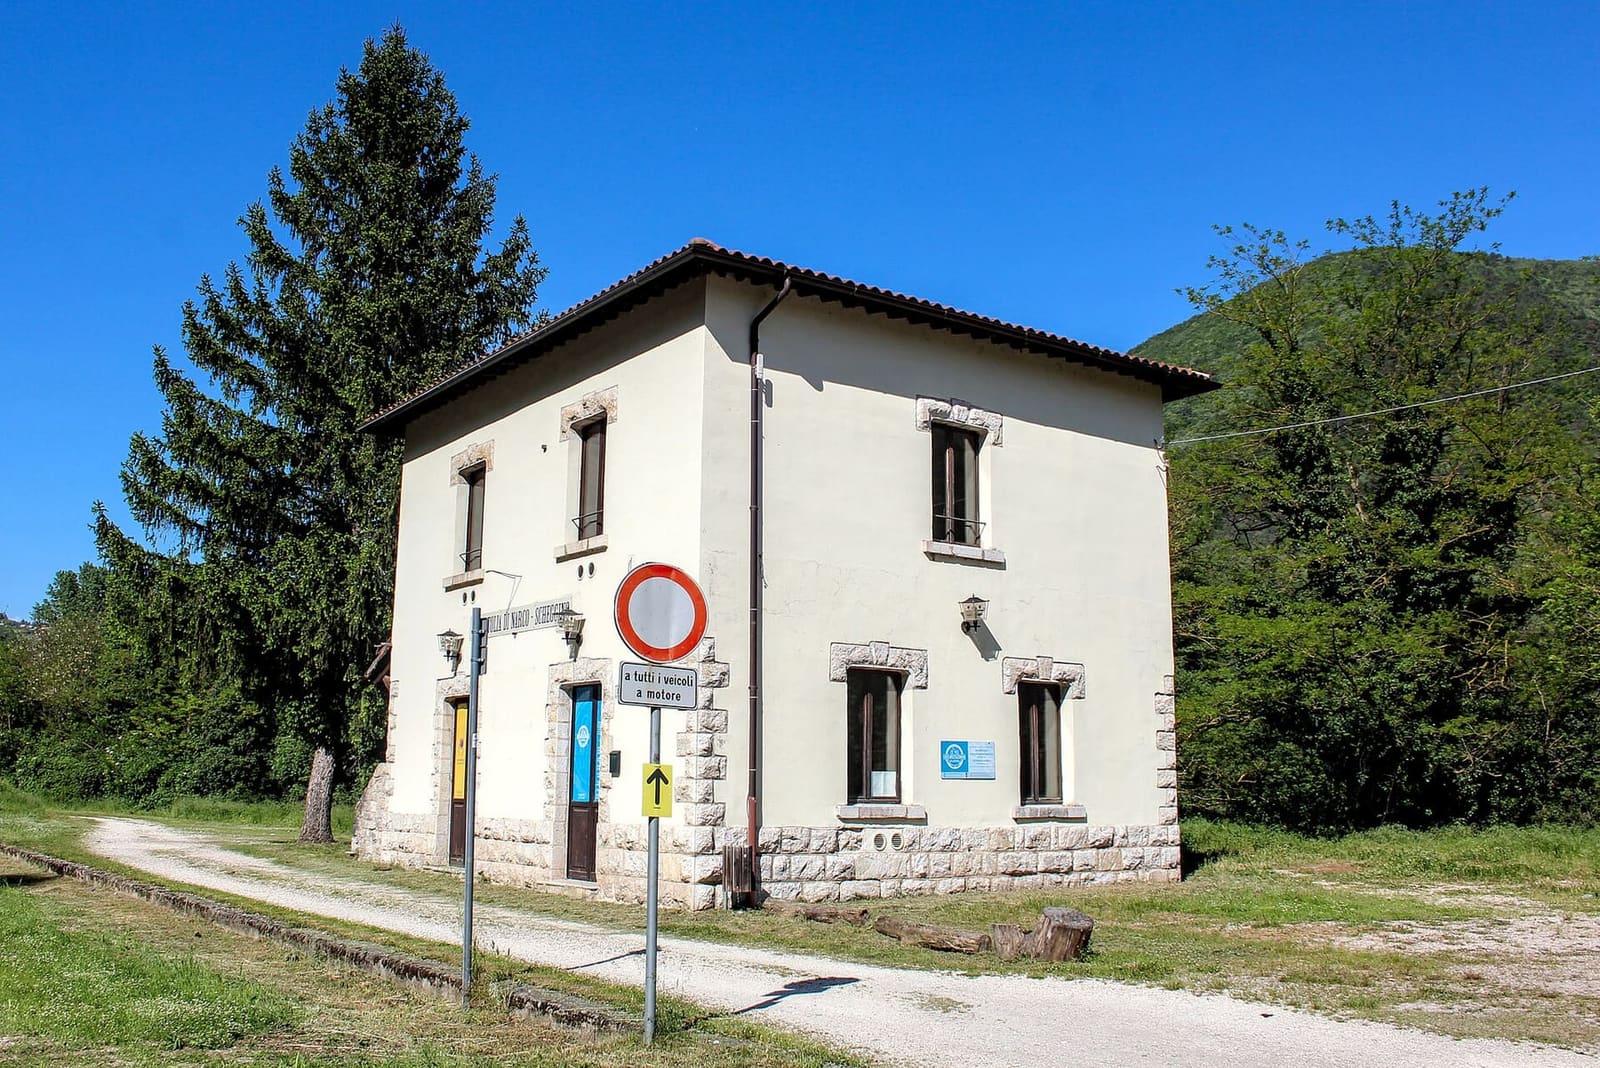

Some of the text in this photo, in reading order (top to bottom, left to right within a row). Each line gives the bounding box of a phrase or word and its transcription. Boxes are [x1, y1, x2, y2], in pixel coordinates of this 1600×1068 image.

[510, 609, 529, 629] NARCO
[624, 671, 693, 687] a tutti i veicoli
[636, 689, 681, 701] a motore
